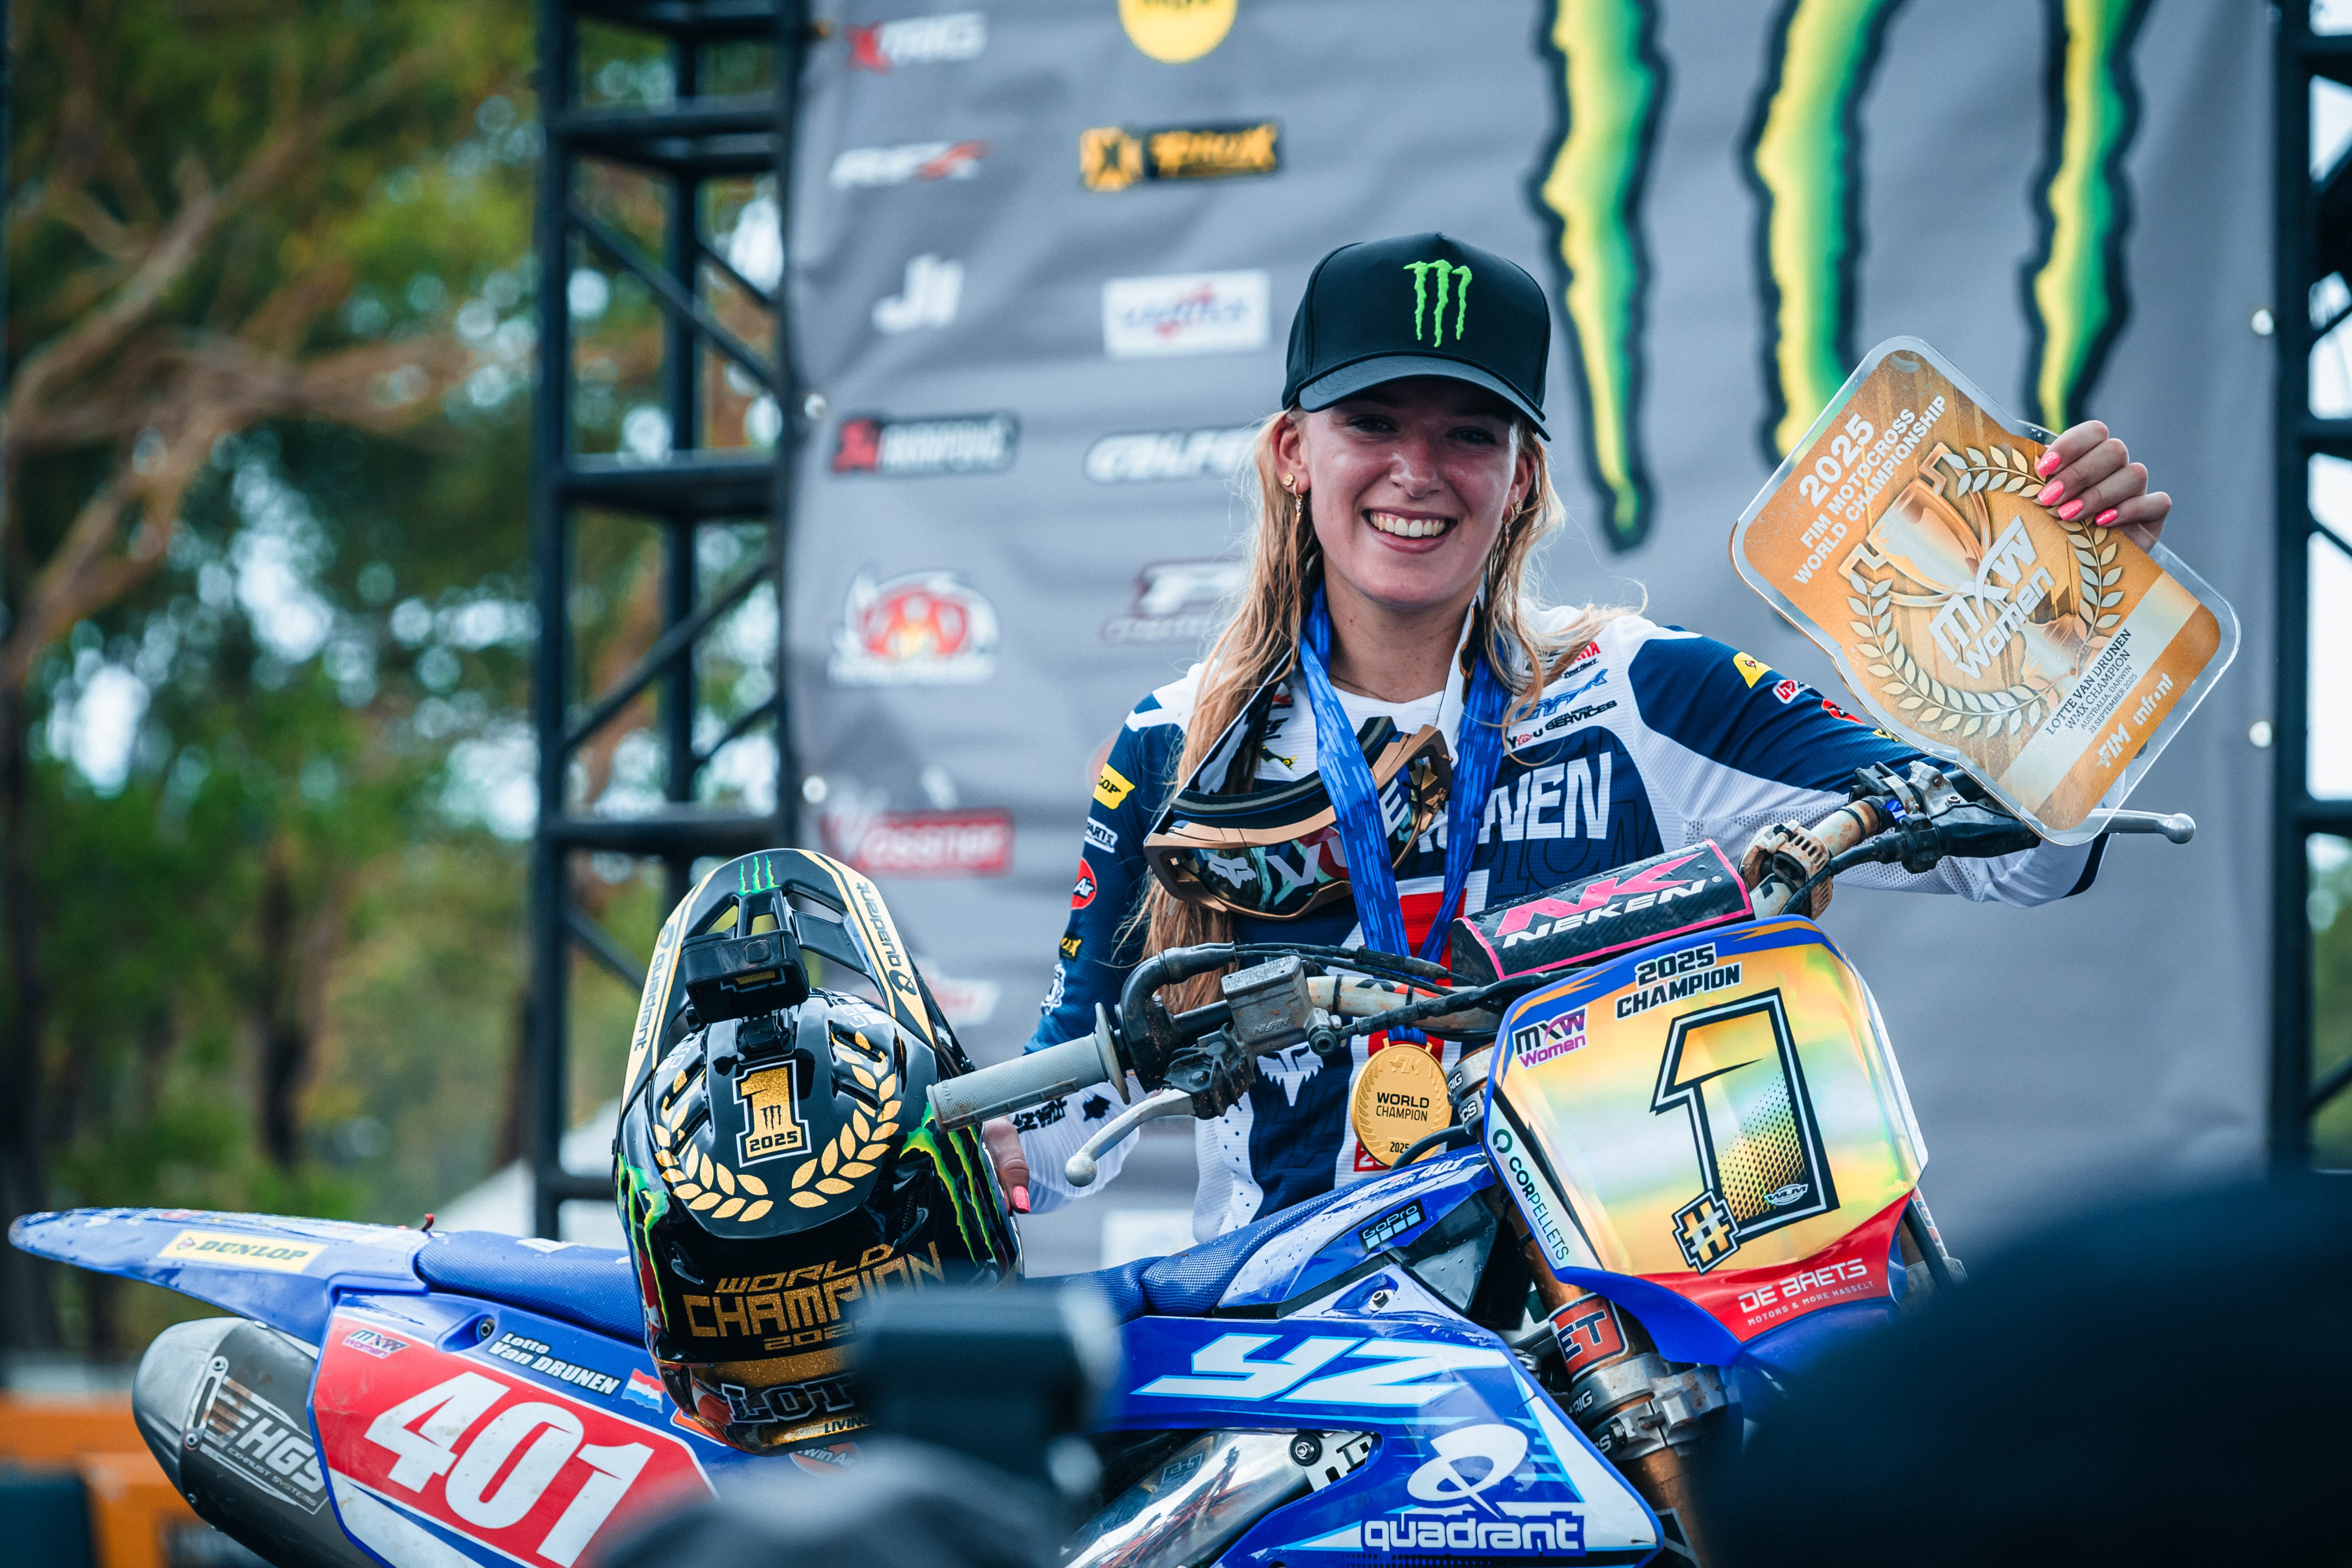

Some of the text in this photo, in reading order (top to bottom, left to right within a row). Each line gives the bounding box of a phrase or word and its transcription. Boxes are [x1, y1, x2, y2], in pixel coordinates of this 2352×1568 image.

[1799, 413, 1874, 507] 2025
[1800, 409, 1915, 549] FIM MOTOCROSS
[1793, 395, 1946, 584] WORLD CHAMPIONSHIP
[2045, 628, 2131, 735] LOTTE VAN DRUNEN
[2065, 649, 2130, 729] WMX CHAMPION
[2081, 665, 2132, 730] AUSTRALIA, DARWIN
[2089, 673, 2137, 733] 21 SEPTEMBER 2025
[1545, 700, 1618, 731] SERVICES
[2096, 723, 2131, 768] FIM
[1074, 878, 1096, 898] Air
[1502, 879, 1707, 948] NEKEN
[1636, 945, 1715, 987] 2025
[634, 952, 665, 1051] quadrant
[1617, 964, 1740, 1018] CHAMPION
[1254, 1018, 1290, 1035] NISSIN
[1515, 1008, 1587, 1055] MXW
[1376, 1106, 1428, 1122] CHAMPION
[1377, 1091, 1430, 1108] WORLD
[749, 1130, 798, 1152] 2025
[1390, 1142, 1410, 1153] 2025
[1767, 1186, 1807, 1201] WLM
[1363, 1205, 1417, 1240] GoPro
[196, 1241, 309, 1260] DUNLOP
[715, 1243, 893, 1294] WORLD
[683, 1241, 946, 1337] CHAMPION
[1738, 1284, 1778, 1313] DE
[1748, 1305, 1788, 1327] MOTORS
[1802, 1292, 1829, 1305] MORE
[1833, 1281, 1874, 1297] HASSELT
[351, 1329, 407, 1351] MXW
[501, 1332, 550, 1355] Lotte
[487, 1341, 621, 1395] Van DRUNEN
[1130, 1333, 1511, 1407] YZ
[226, 1447, 318, 1506] EXHAUST SYSTEMS
[235, 1417, 325, 1493] HGS
[364, 1371, 654, 1568] 401
[1364, 1512, 1582, 1552] quadrant
